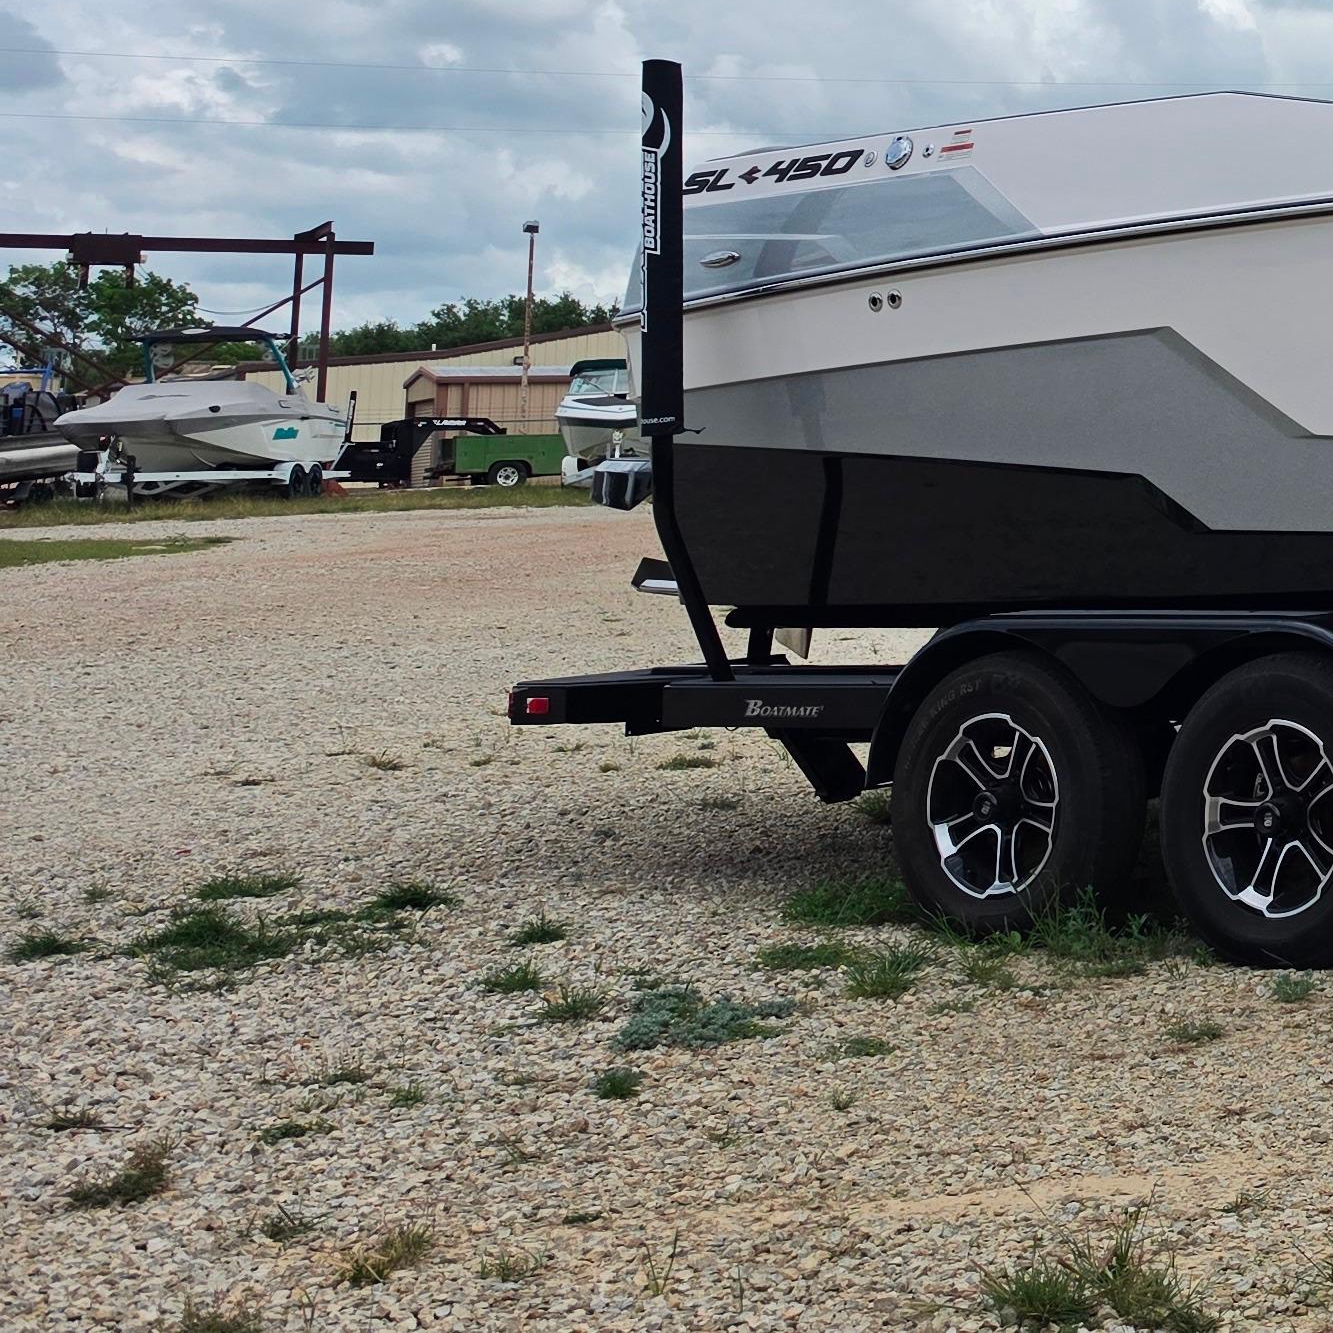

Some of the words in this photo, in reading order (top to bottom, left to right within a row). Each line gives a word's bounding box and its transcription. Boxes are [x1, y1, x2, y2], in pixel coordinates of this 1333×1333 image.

[643, 151, 656, 249] BOATHOUSE
[682, 168, 735, 196] SL
[762, 149, 865, 183] 450
